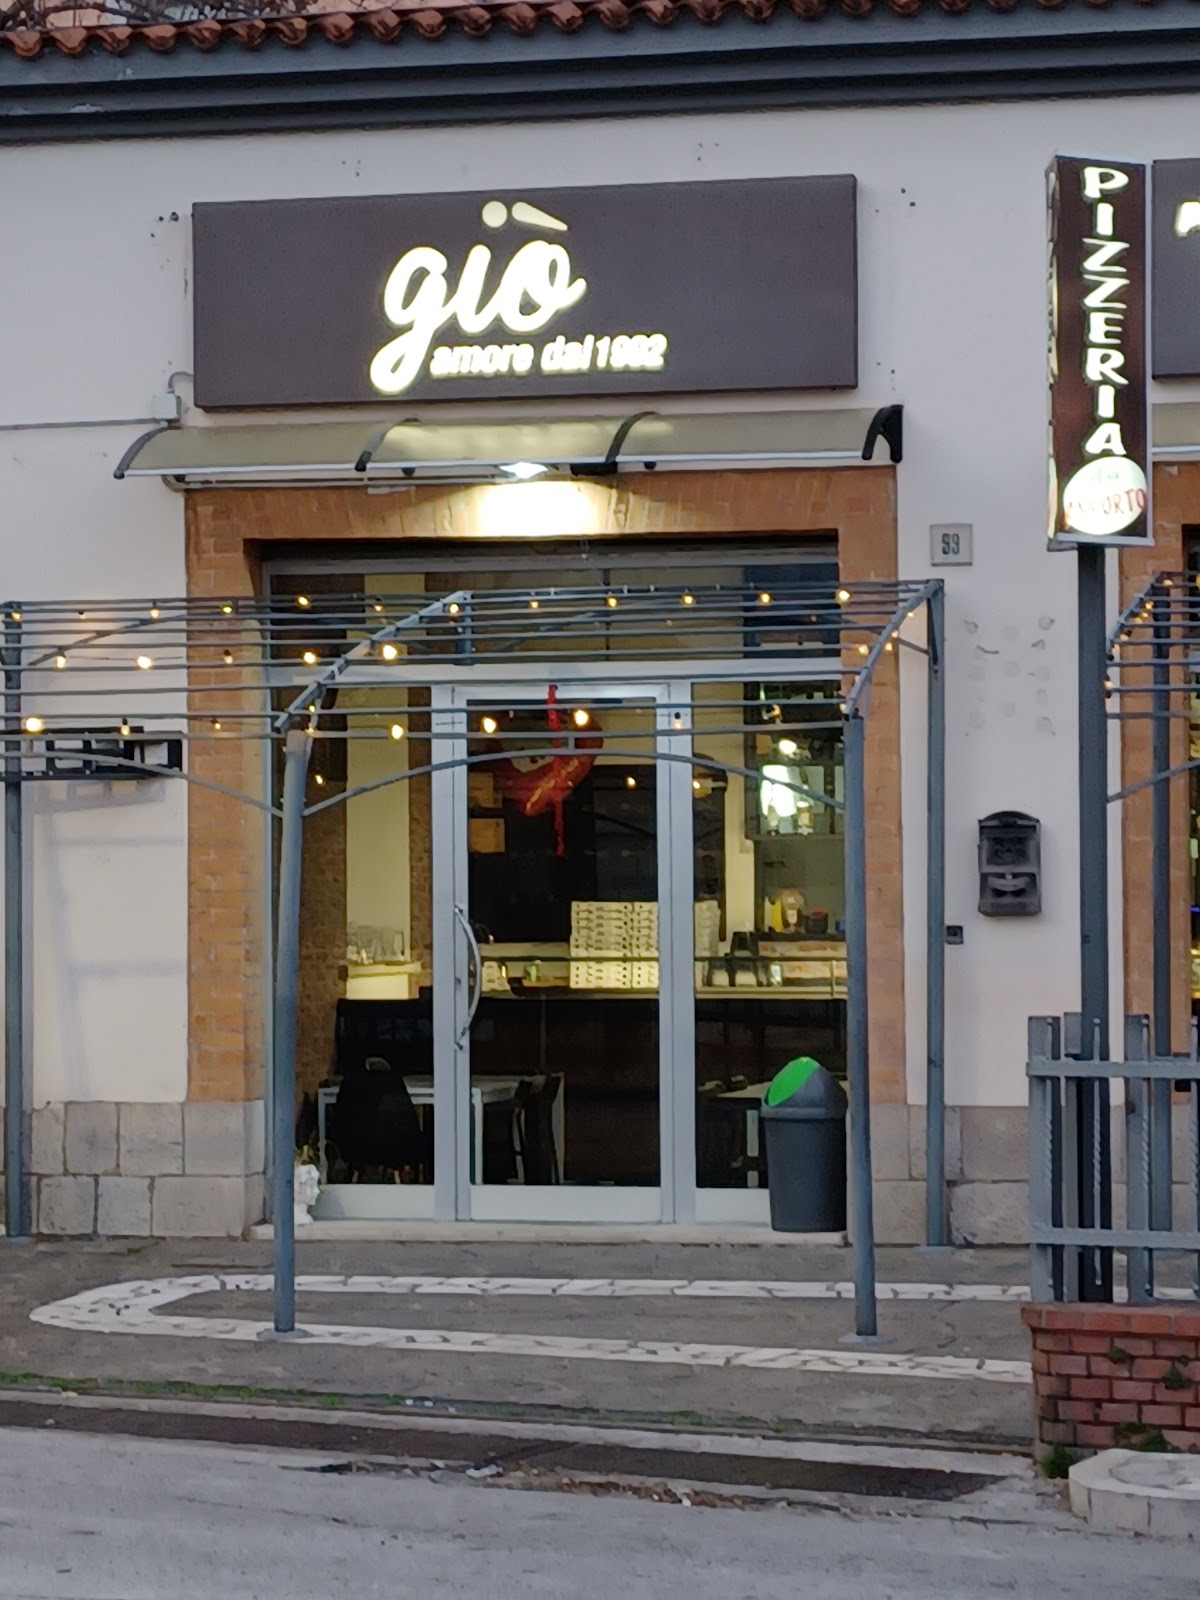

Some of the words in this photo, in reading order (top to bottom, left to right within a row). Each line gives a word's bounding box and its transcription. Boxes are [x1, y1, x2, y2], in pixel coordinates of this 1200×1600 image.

[429, 343, 535, 378] amore
[540, 334, 595, 374] dal
[1081, 166, 1131, 457] PIZZERIA
